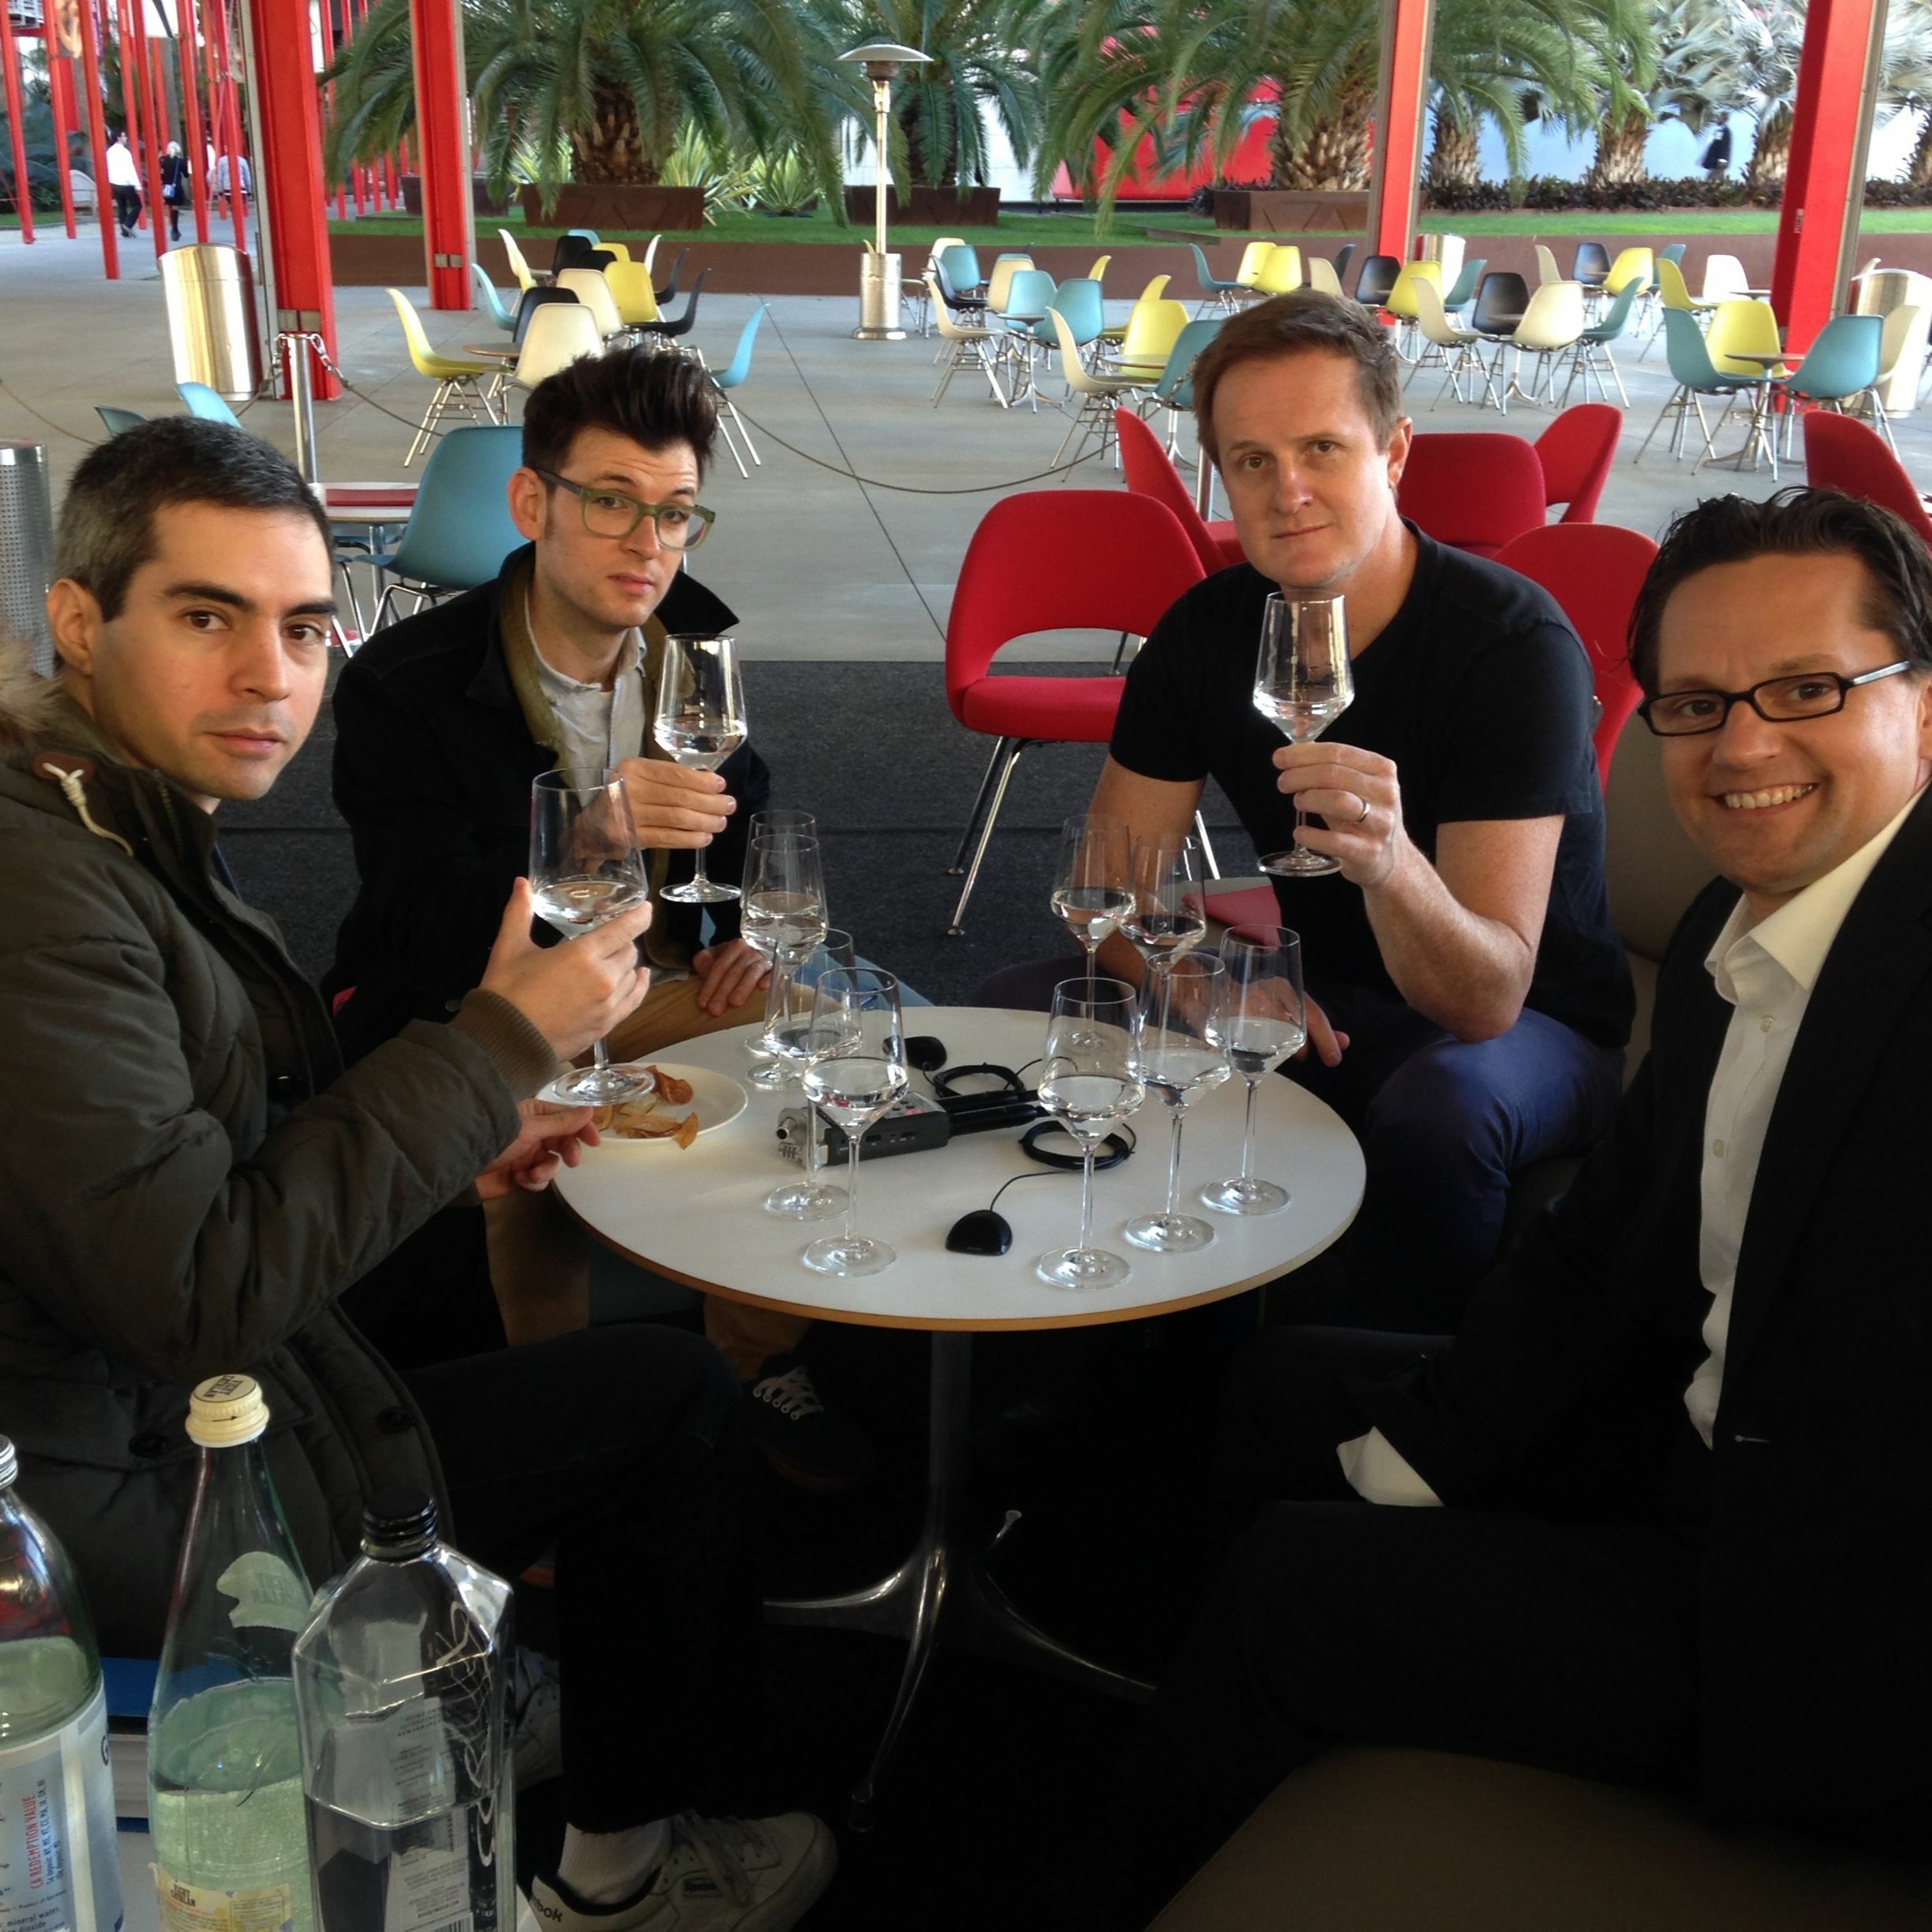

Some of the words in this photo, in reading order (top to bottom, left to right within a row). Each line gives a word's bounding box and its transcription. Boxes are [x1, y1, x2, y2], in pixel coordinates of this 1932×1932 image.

[21, 1794, 37, 1823] VALUE
[25, 1823, 42, 1877] REDEMPTION
[30, 1876, 44, 1889] CA
[7, 1913, 36, 1926] mineral
